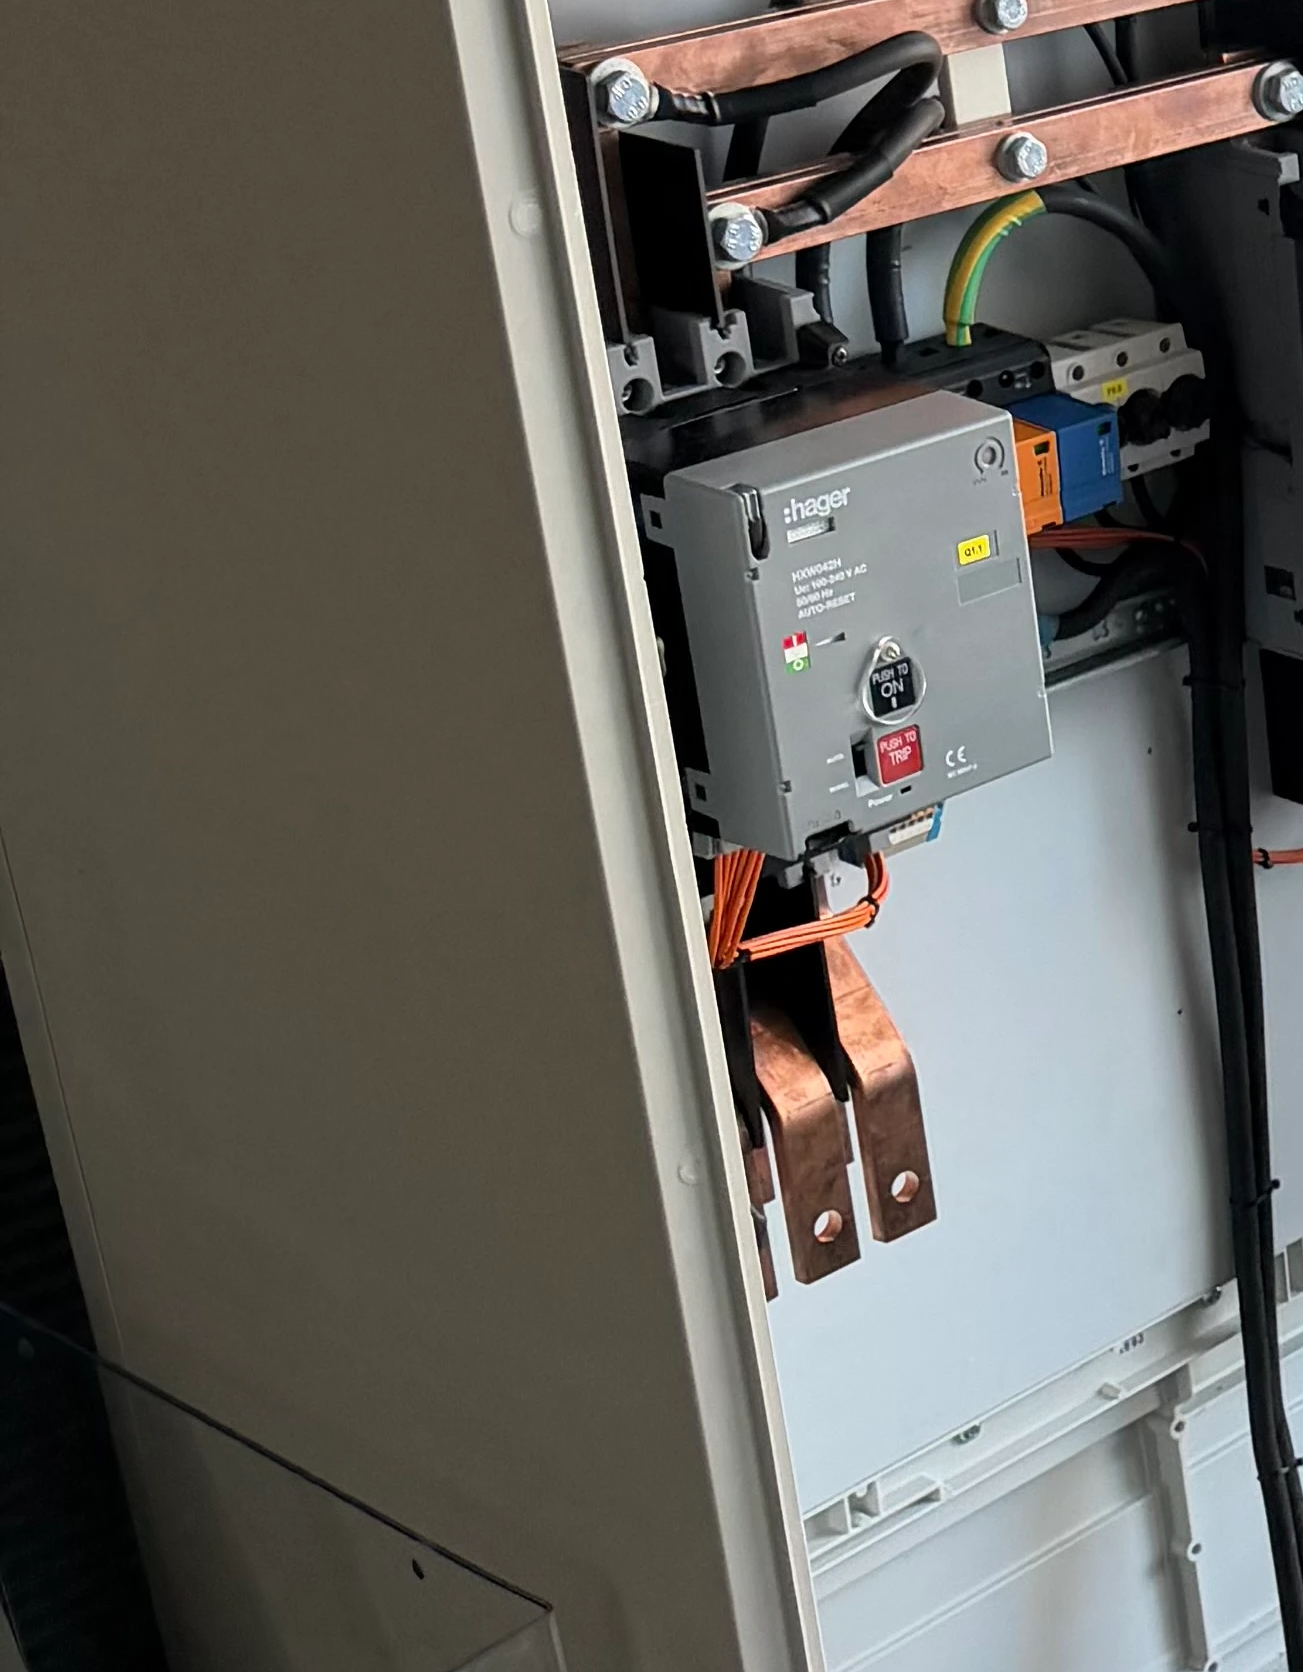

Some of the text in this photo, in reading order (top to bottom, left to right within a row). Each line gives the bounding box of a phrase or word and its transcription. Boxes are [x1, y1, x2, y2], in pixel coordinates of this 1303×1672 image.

[964, 544, 983, 557] Q1.1
[872, 662, 909, 686] PUSH TO
[880, 678, 904, 699] ON
[879, 730, 917, 754] PUSH TO
[888, 745, 912, 767] TRIP
